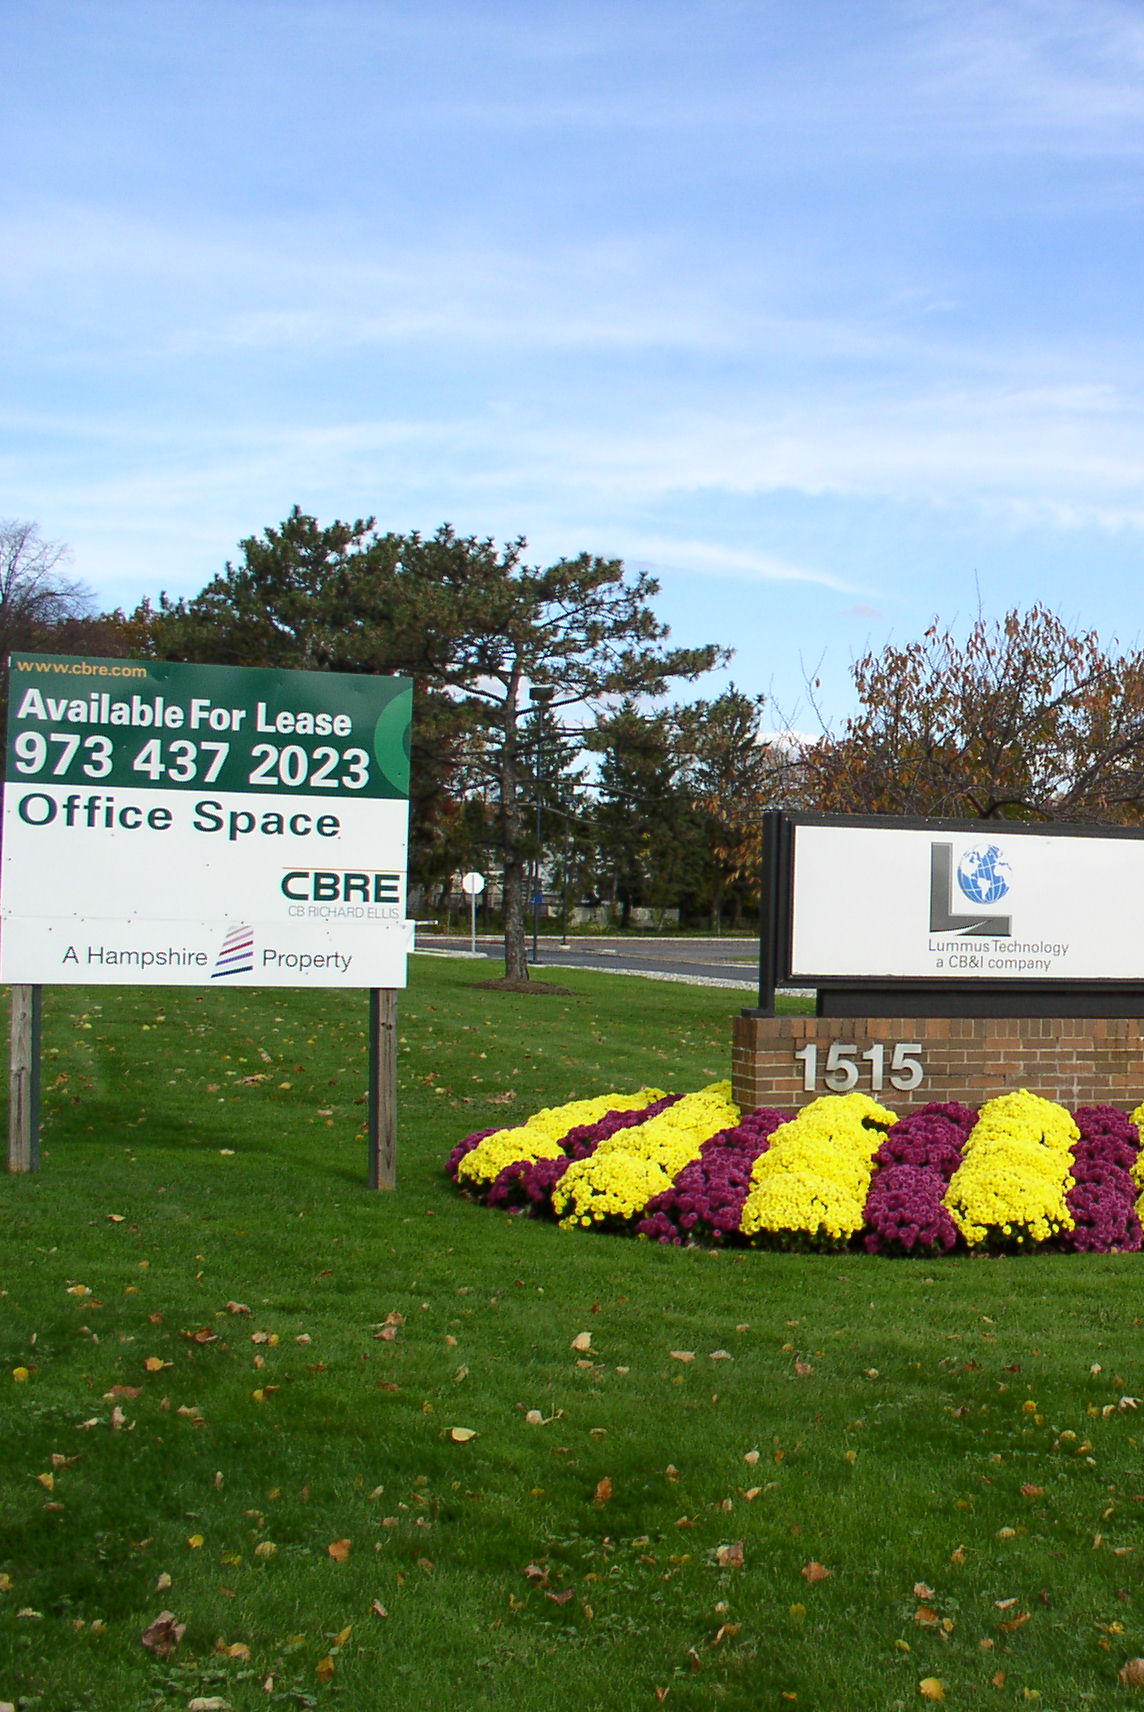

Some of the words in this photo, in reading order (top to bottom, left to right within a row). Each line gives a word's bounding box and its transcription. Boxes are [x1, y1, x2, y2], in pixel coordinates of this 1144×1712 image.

[17, 661, 147, 678] www.cbre.com
[17, 688, 184, 728] Available
[190, 699, 246, 731] For
[256, 702, 352, 736] Lease
[14, 731, 113, 778] 973
[133, 739, 230, 782] 437
[249, 744, 370, 789] 2023
[18, 793, 173, 831] Office
[193, 800, 341, 841] Space
[281, 872, 400, 903] CBRE
[288, 906, 307, 917] CB
[309, 906, 364, 919] RICHARD
[366, 907, 399, 919] ELLIS
[63, 946, 79, 964] A
[88, 946, 208, 970] Hampshire
[263, 950, 352, 972] Property
[929, 939, 989, 953] Lummus
[992, 940, 1069, 957] Technology
[936, 958, 944, 968] a
[949, 956, 984, 969] CB&I
[988, 958, 1051, 972] company
[795, 1043, 924, 1092] 1515
